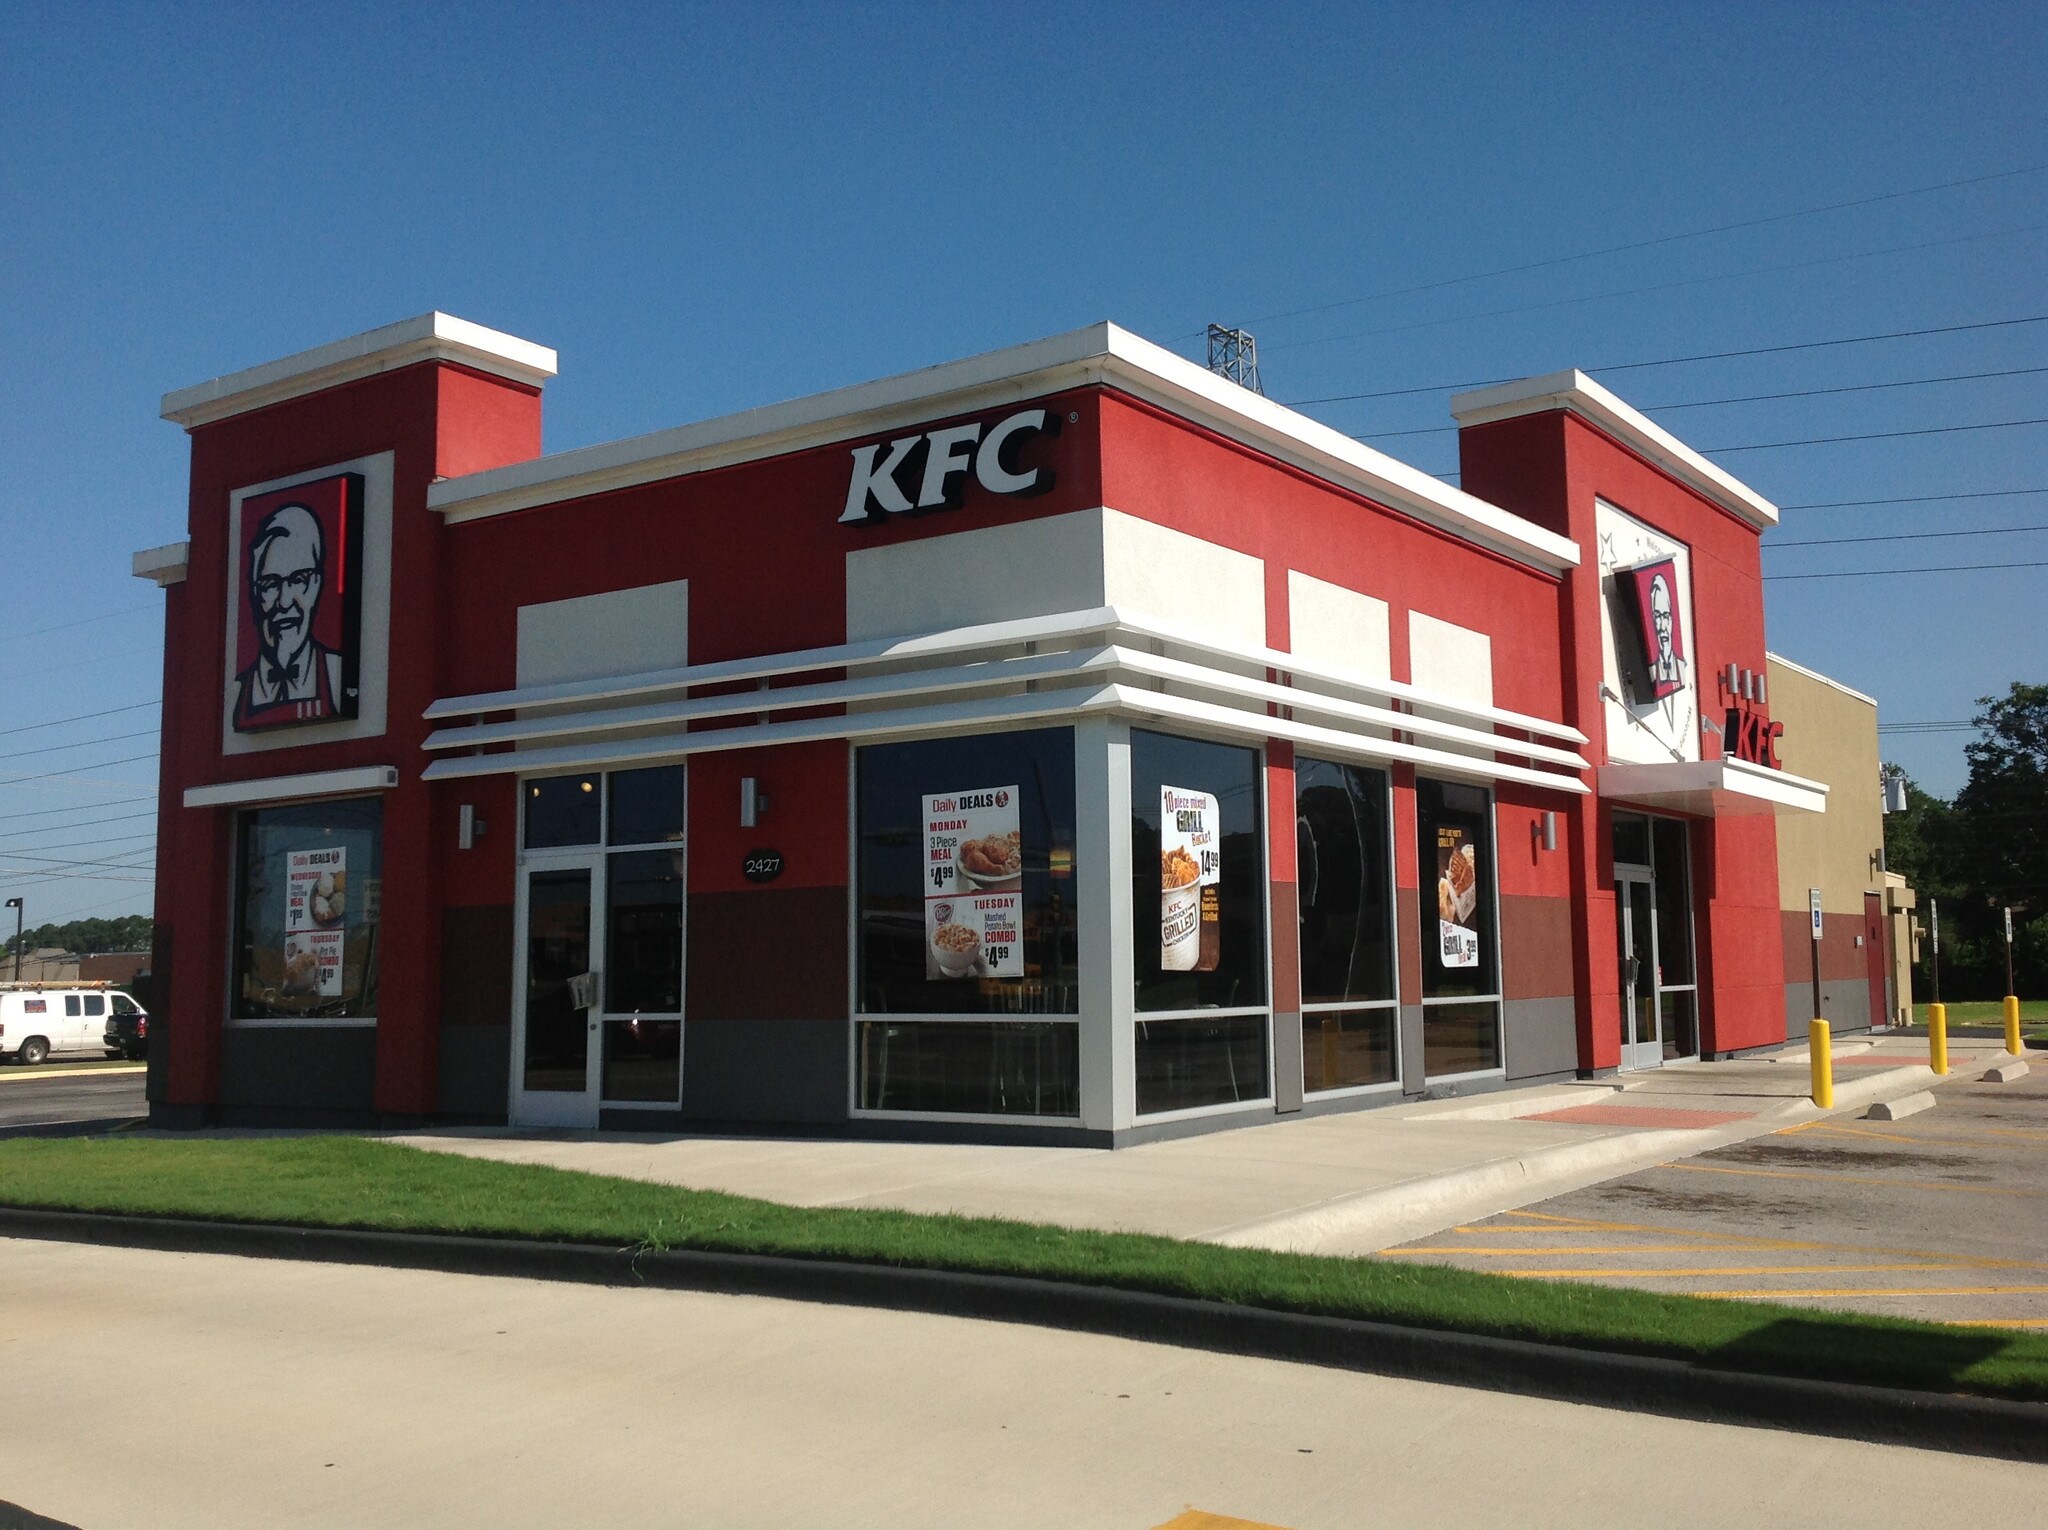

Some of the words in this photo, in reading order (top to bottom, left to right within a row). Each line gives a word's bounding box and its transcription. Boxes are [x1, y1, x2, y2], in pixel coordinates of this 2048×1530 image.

[837, 409, 1046, 523] KFC
[1735, 707, 1783, 770] KFC
[932, 798, 957, 813] Daily
[959, 793, 993, 810] DEALS
[1163, 790, 1174, 814] 10
[1174, 797, 1190, 809] piece
[1190, 796, 1207, 809] mixed
[929, 819, 968, 832] MONDAY
[1176, 810, 1204, 833] GRILL
[930, 837, 936, 848] 3
[936, 835, 957, 848] Piece
[1191, 829, 1211, 847] Bucket
[293, 855, 308, 867] Daily
[309, 852, 331, 865] DEALS
[930, 848, 952, 861] MEAL
[746, 858, 780, 873] 2427
[974, 898, 1015, 910] TUESDAY
[1168, 900, 1182, 915] KFC
[984, 912, 1006, 922] Mashed
[1165, 908, 1189, 924] KENTUCKY
[984, 921, 1001, 931] Potato
[1002, 920, 1016, 930] Bowl
[1163, 912, 1195, 941] GRILLED
[985, 930, 1016, 944] COMBO
[1443, 934, 1463, 955] GRILL
